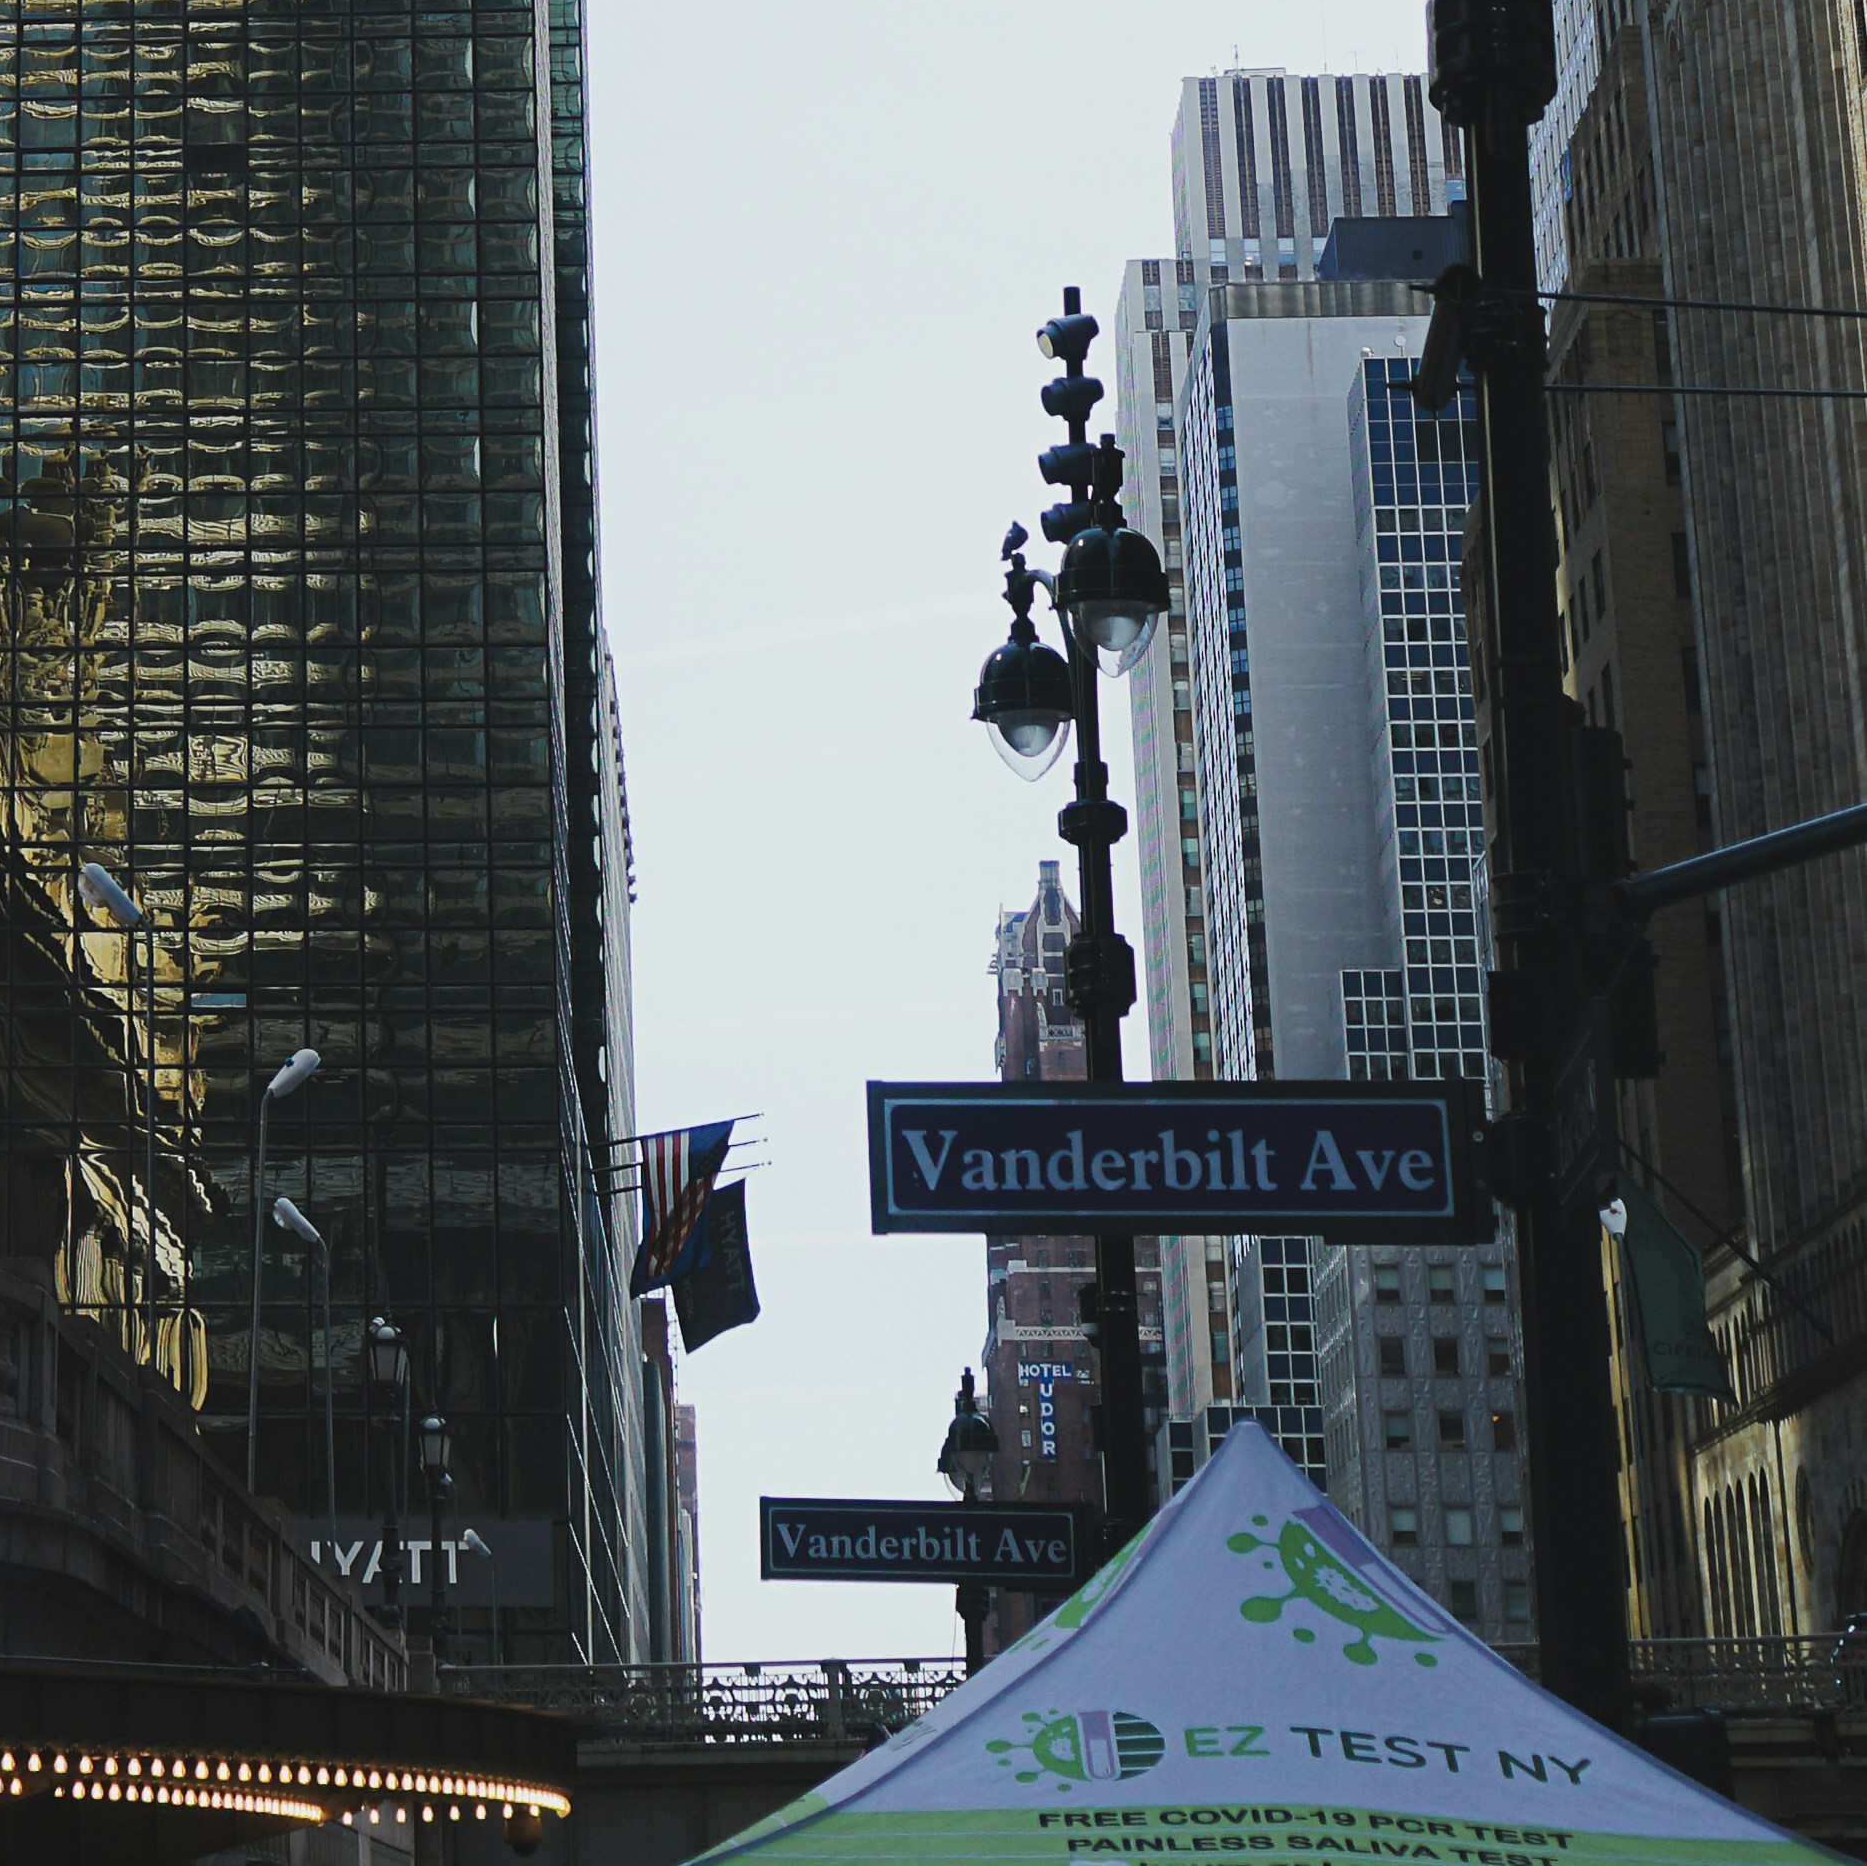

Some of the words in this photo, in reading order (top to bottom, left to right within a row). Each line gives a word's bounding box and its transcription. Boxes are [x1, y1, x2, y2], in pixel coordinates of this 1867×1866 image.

[901, 1128, 1279, 1193] Vanderbilt
[1299, 1129, 1435, 1193] Ave
[720, 1210, 746, 1292] HYATT
[1020, 1363, 1072, 1377] HOTEL
[776, 1523, 982, 1562] Vanderbilt
[993, 1527, 1068, 1564] Ave
[1183, 1725, 1271, 1758] EZ
[1289, 1726, 1471, 1773] TEST
[1497, 1749, 1592, 1786] NY
[1038, 1811, 1148, 1828] FREE
[1159, 1808, 1356, 1827] COVID-19
[1369, 1814, 1457, 1838] PCR
[1465, 1824, 1574, 1850] TEST
[1067, 1835, 1275, 1853] PAINLESS
[1287, 1835, 1441, 1861] SALIVA
[1448, 1848, 1559, 1866] TEST
